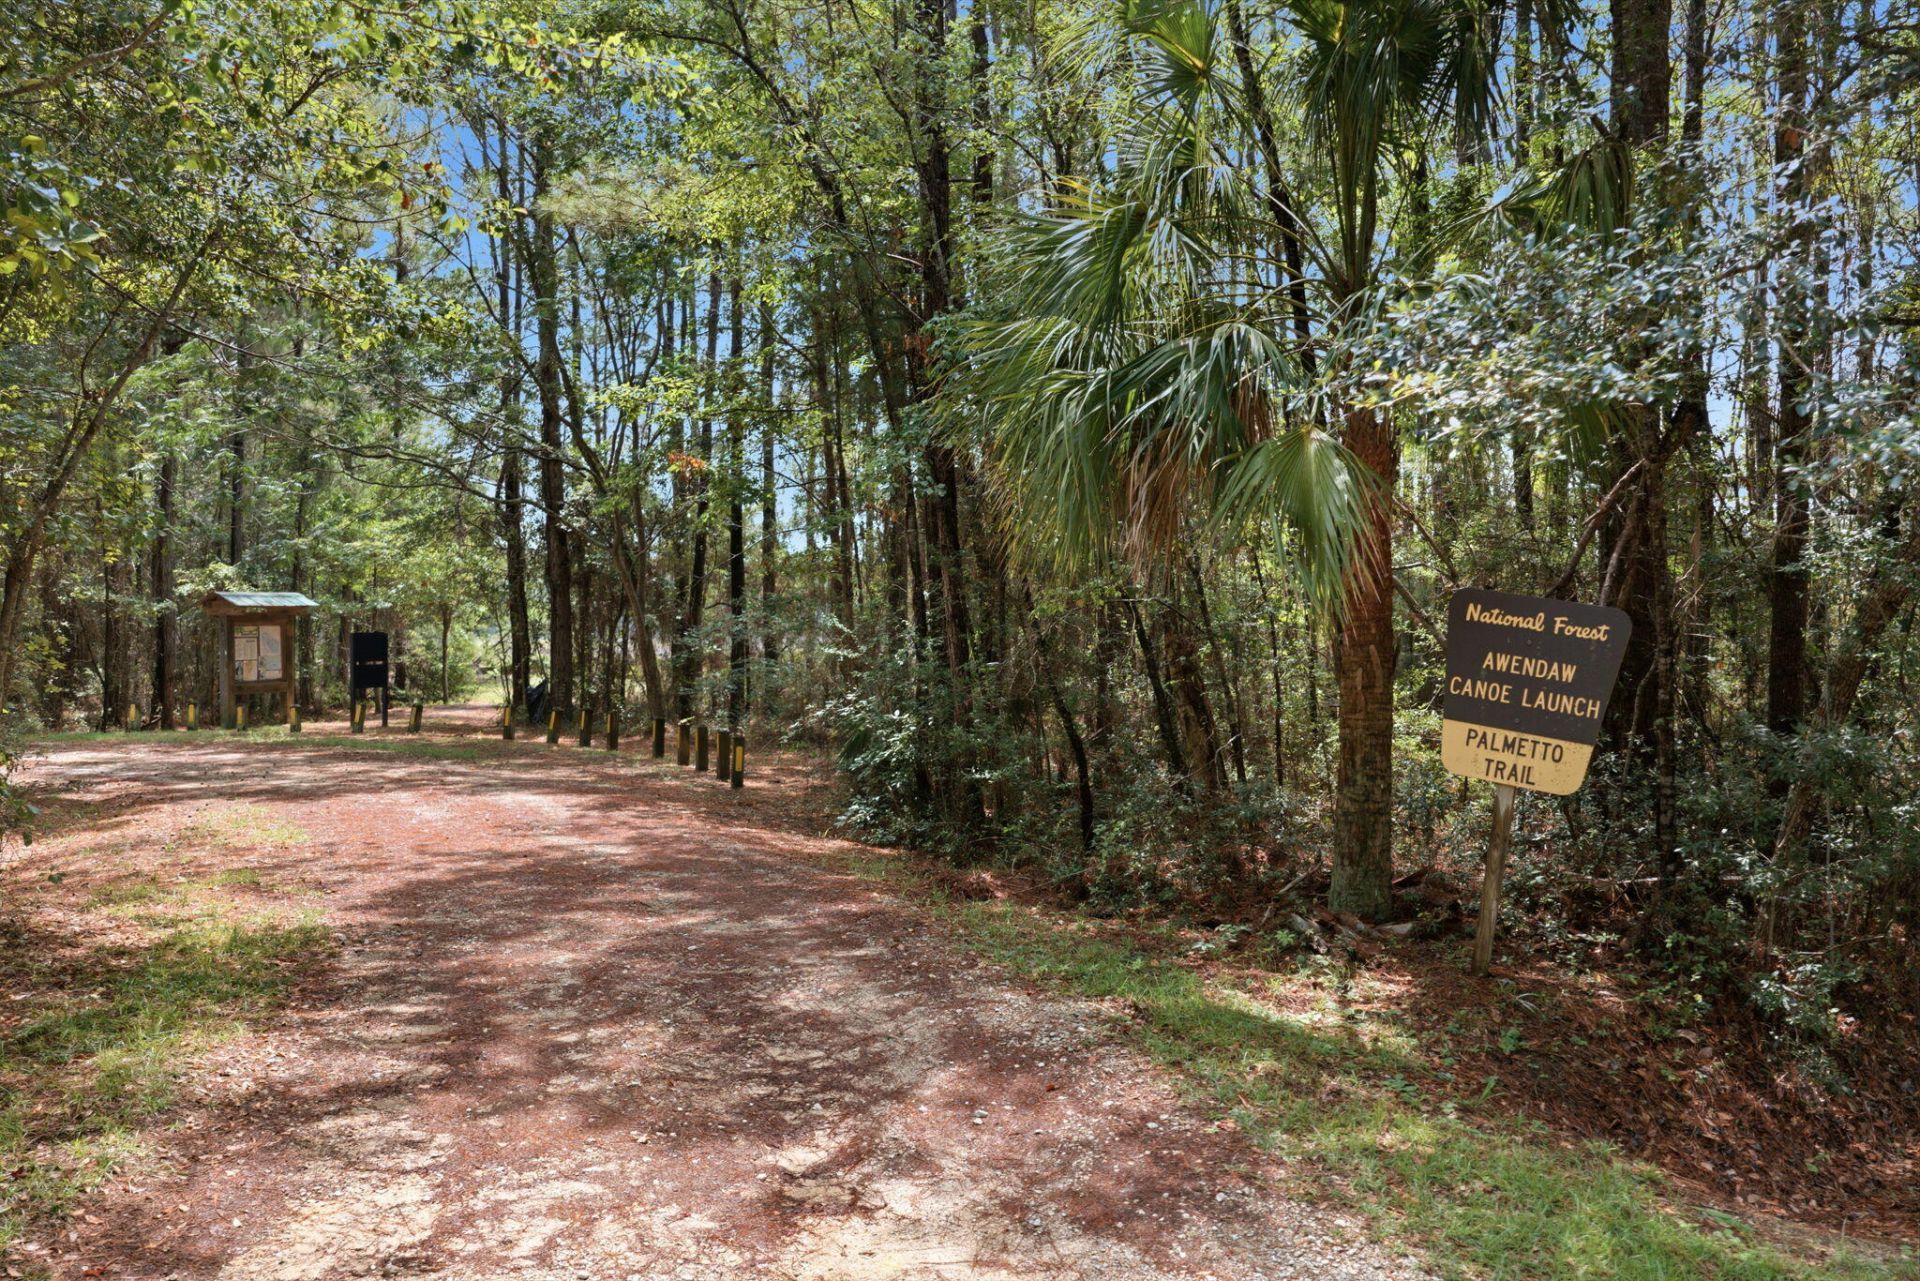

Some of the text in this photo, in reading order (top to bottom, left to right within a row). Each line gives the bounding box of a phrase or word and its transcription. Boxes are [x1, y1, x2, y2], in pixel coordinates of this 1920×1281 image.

[1466, 603, 1610, 642] National Forest
[1483, 651, 1577, 683] AWENDAW
[1450, 676, 1600, 719] CANOE LAUNCH
[1466, 728, 1564, 764] PALMETTO
[1484, 758, 1535, 786] TRAIL
